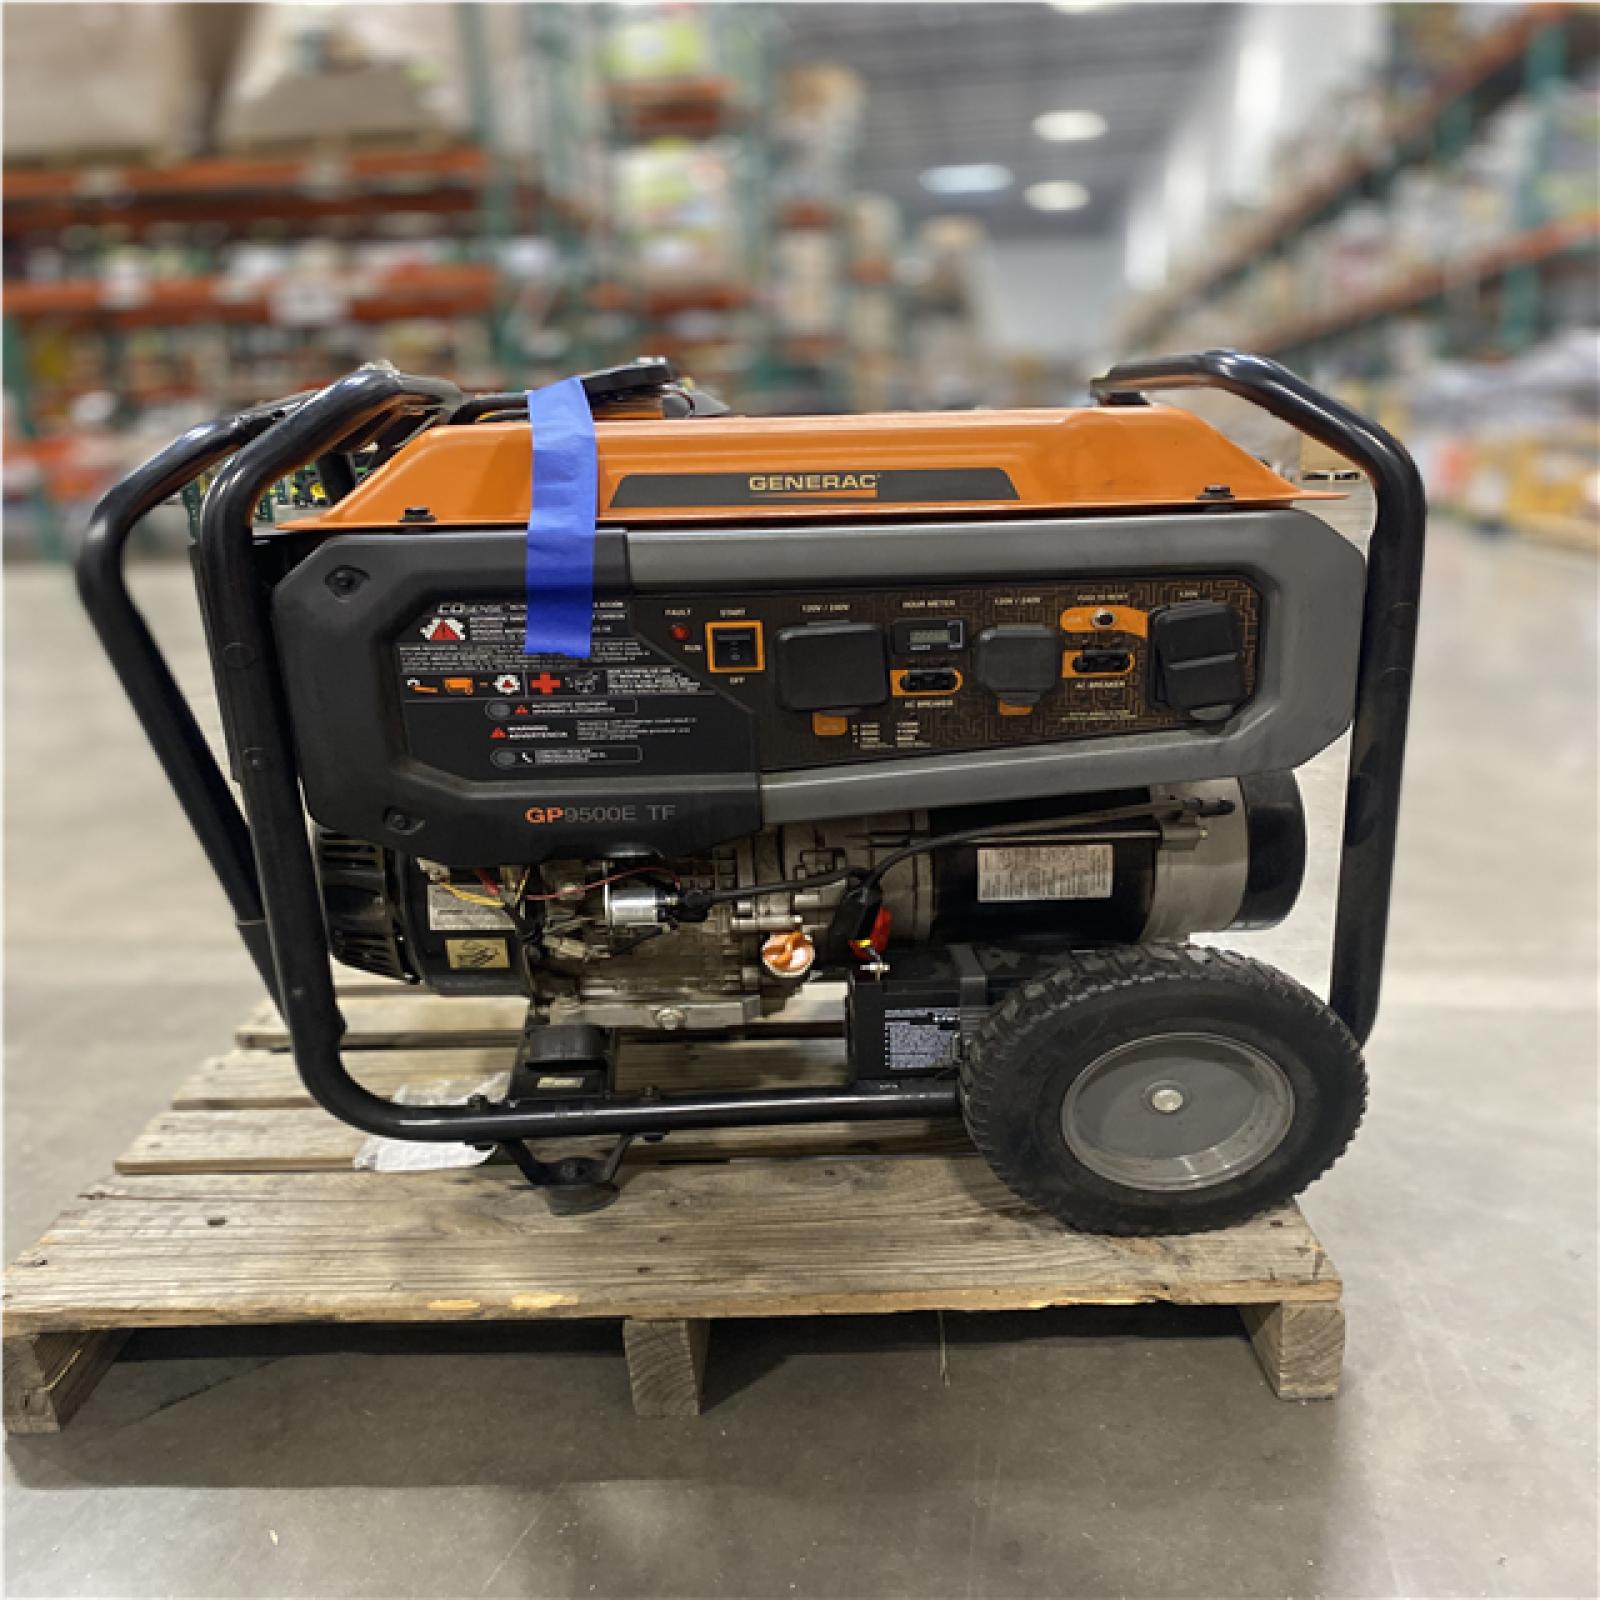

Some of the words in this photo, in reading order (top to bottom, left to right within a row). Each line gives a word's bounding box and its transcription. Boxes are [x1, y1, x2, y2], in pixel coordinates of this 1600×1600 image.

[748, 474, 878, 491] GENERAC
[525, 804, 637, 824] GP9500E
[646, 804, 676, 822] TF
